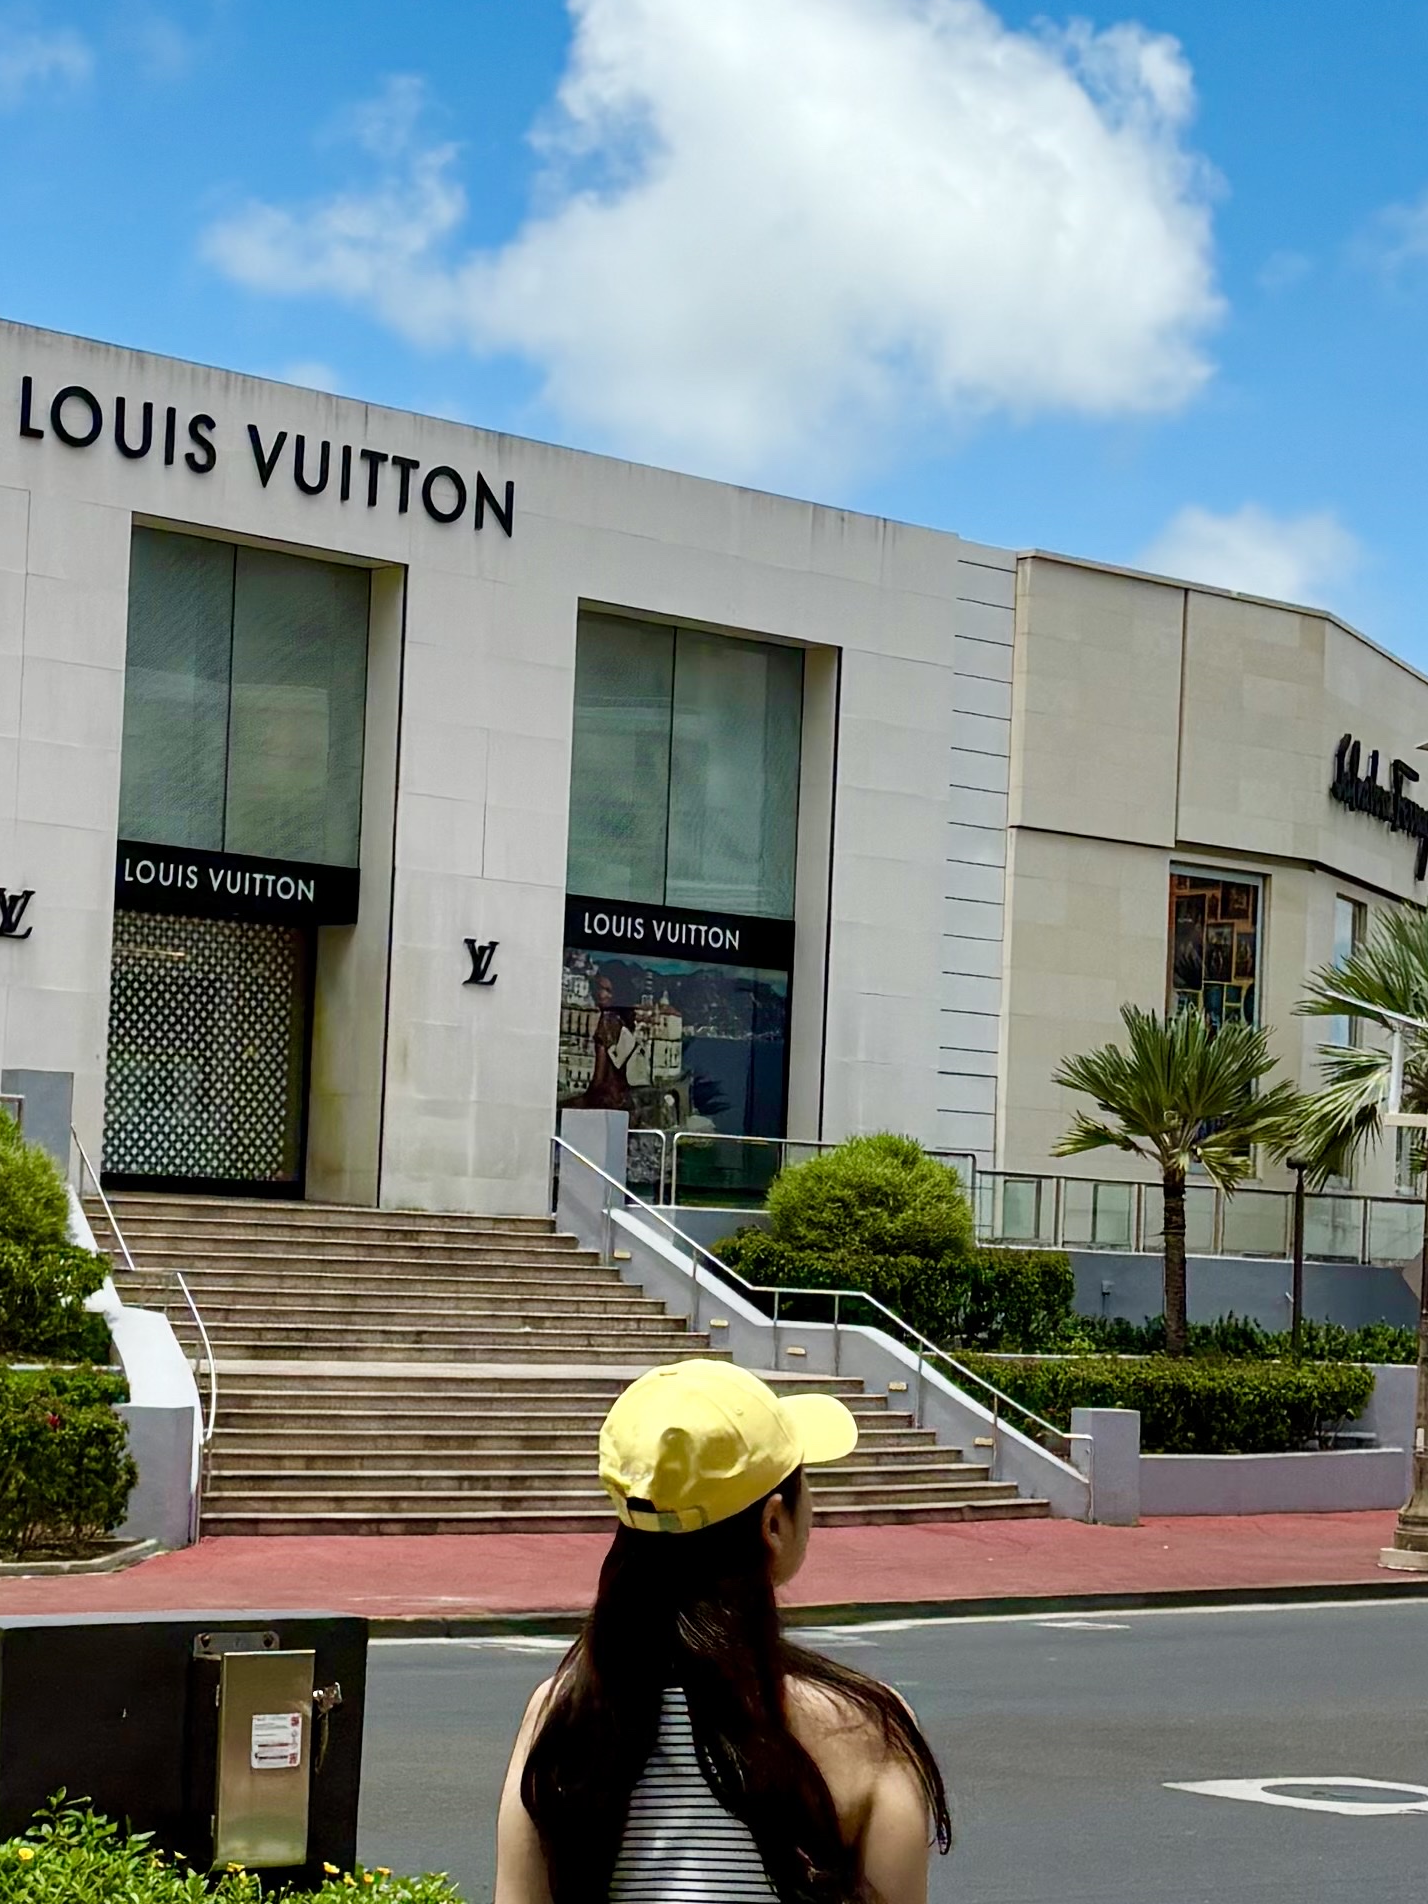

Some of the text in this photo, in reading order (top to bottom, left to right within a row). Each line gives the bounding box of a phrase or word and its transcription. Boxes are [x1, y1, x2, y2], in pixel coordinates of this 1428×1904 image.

[19, 375, 515, 539] LOUIS VUITTON
[124, 858, 315, 902] LOUIS VUITTON
[584, 911, 740, 951] LOUIS VUITTON
